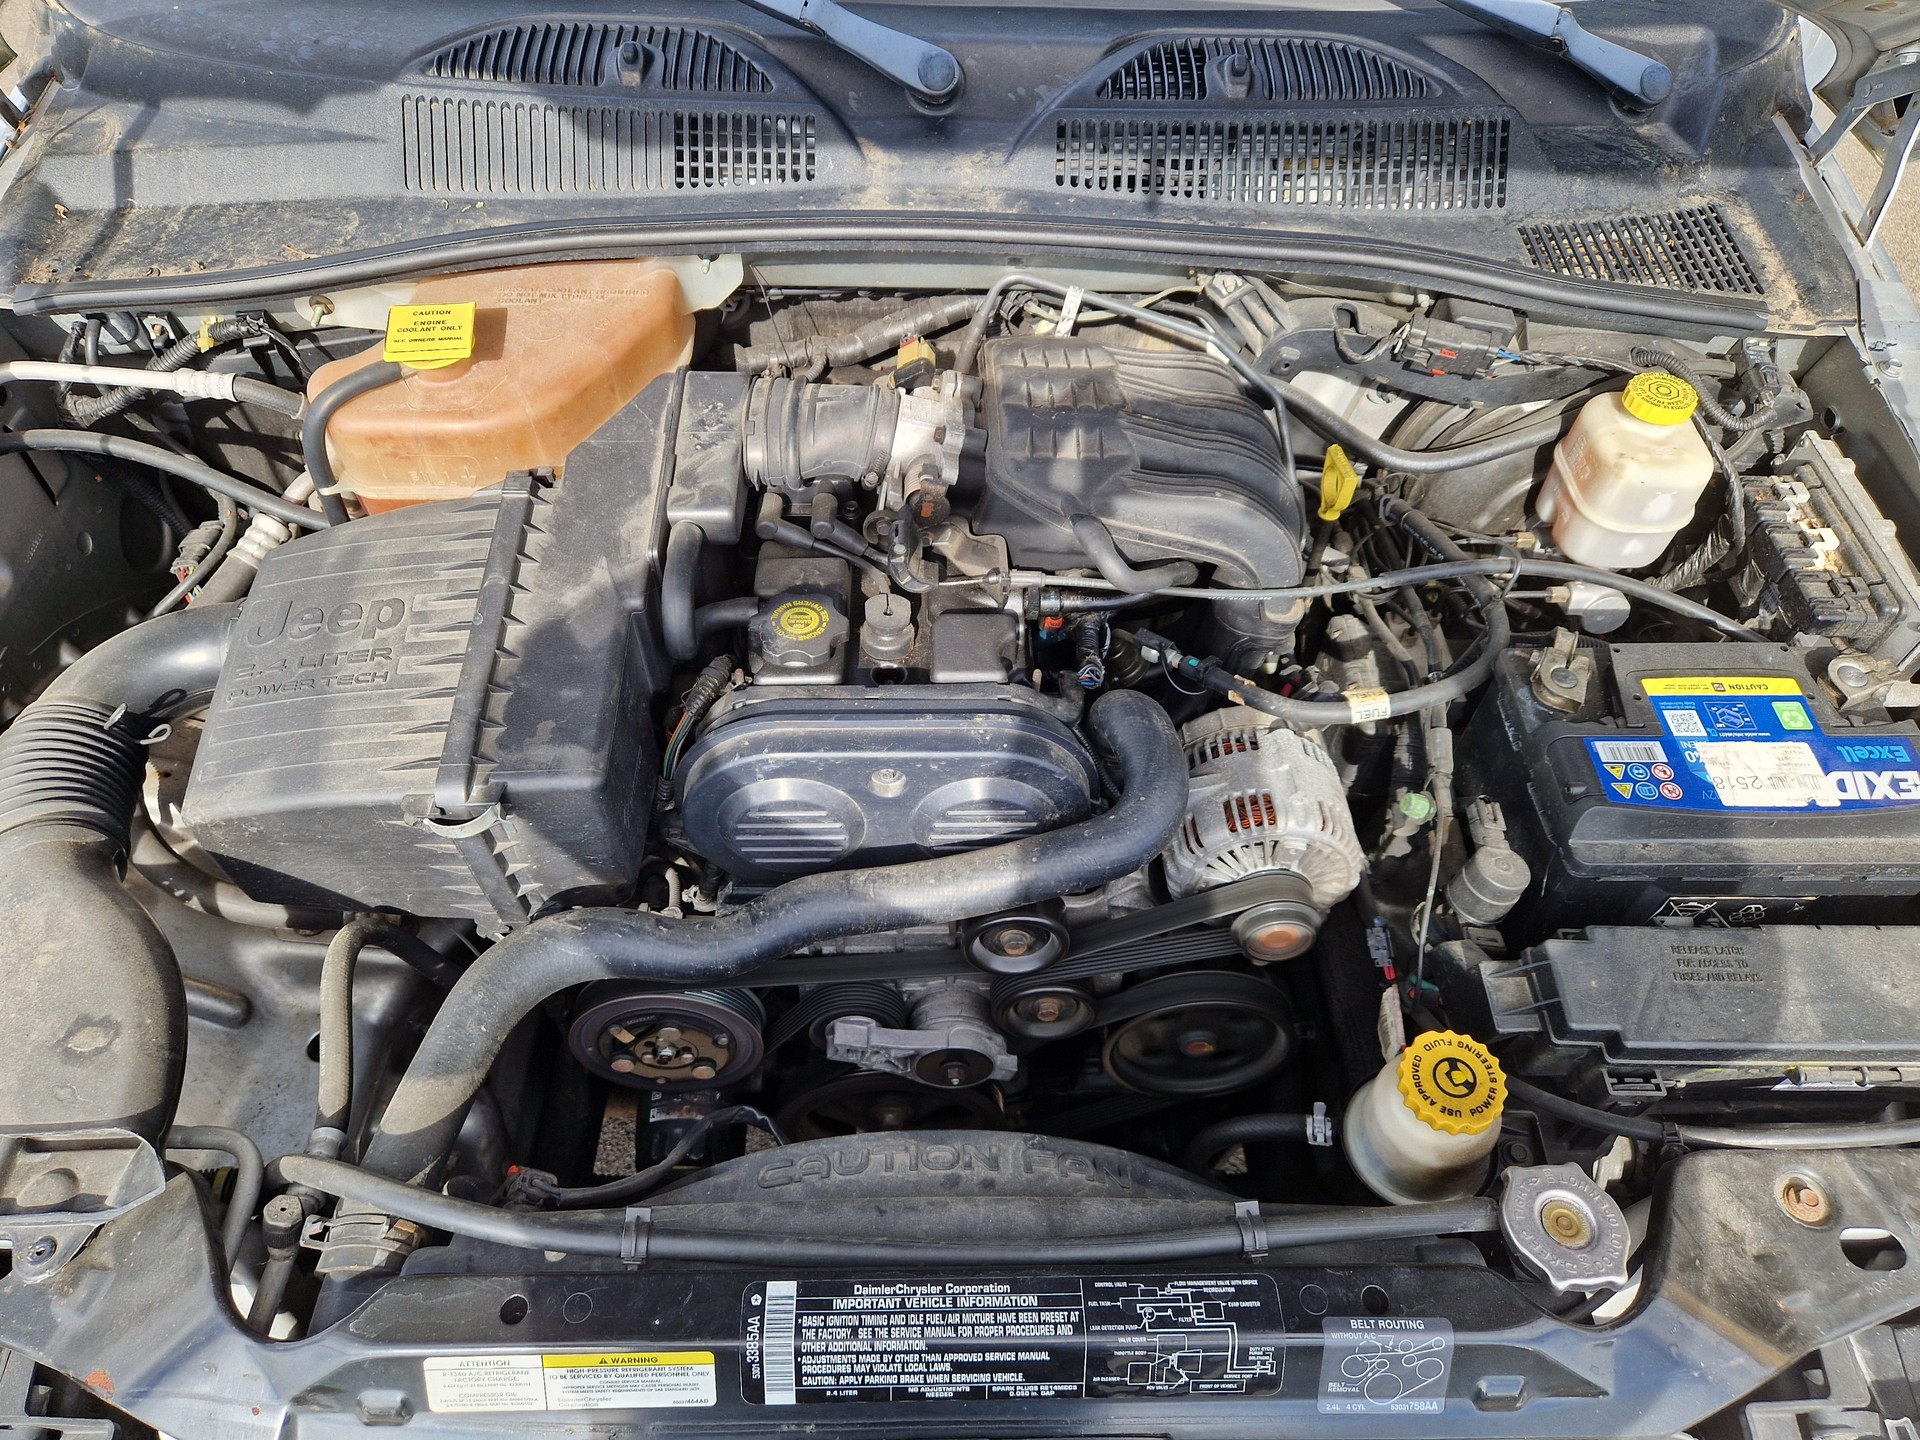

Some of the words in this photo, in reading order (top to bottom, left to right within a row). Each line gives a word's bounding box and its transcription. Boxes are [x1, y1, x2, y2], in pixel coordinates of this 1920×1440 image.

[771, 601, 792, 620] MANUAL
[793, 600, 822, 611] OWNERS
[819, 608, 830, 622] SEE
[247, 598, 405, 647] Jeep
[235, 659, 287, 680] 2.4
[299, 647, 393, 669] LITER
[226, 678, 315, 703] POWER
[322, 672, 389, 688] TECH
[1728, 682, 1769, 691] CAUTION
[1356, 707, 1387, 719] FUEL
[1837, 745, 1912, 763] Excell
[1714, 774, 1762, 790] 2518
[1670, 945, 1710, 955] RELEASE
[1714, 946, 1745, 956] LATCH
[1676, 958, 1696, 968] FOR
[1698, 959, 1734, 968] ACCESS
[1736, 959, 1748, 968] TO
[1672, 972, 1704, 981] FUSES
[1707, 972, 1725, 982] AND
[1423, 1039, 1452, 1051] FLUID
[1457, 1041, 1497, 1083] STEERING
[1412, 1055, 1437, 1106] APPROVED
[1469, 1087, 1497, 1116] POWER
[1440, 1105, 1462, 1118] USE
[756, 1144, 999, 1189] CAUTION
[1020, 1149, 1131, 1189] FAN
[854, 1283, 942, 1296] DaimlerChrysler
[945, 1283, 1011, 1295] Corporation
[832, 1298, 901, 1310] IMPORTANT
[905, 1297, 953, 1308] VEHICLE
[957, 1296, 1038, 1307] INFORMATION
[802, 1316, 824, 1327] BASIC
[826, 1315, 859, 1326] IGNITION
[861, 1315, 888, 1326] TIMING
[889, 1315, 906, 1325] AND
[907, 1313, 924, 1325] IDLE
[926, 1313, 960, 1326] FUEL/AIR
[962, 1313, 995, 1324] MIXTURE
[997, 1312, 1017, 1324] HAVE
[1019, 1312, 1039, 1323] BEEN
[1040, 1312, 1068, 1323] PRESET
[1070, 1311, 1080, 1323] AT
[1350, 1320, 1375, 1329] BELT
[1378, 1320, 1424, 1330] ROUTING
[802, 1329, 816, 1339] THE
[819, 1328, 853, 1339] FACTORY.
[858, 1328, 872, 1338] SEE
[875, 1328, 889, 1338] THE
[890, 1326, 922, 1338] SERVICE
[924, 1326, 956, 1337] MANUAL
[958, 1326, 972, 1336] FOR
[975, 1325, 1004, 1336] PROPER
[1006, 1325, 1055, 1336] PROCEDURES
[1057, 1324, 1073, 1335] AND
[801, 1342, 826, 1353] OTHER
[828, 1342, 872, 1352] ADDITIONAL
[874, 1340, 928, 1352] INFORMATION.
[801, 1355, 857, 1364] ADJUSTMENTS
[859, 1354, 881, 1363] MADE
[883, 1354, 893, 1362] BY
[894, 1354, 919, 1362] OTHER
[921, 1354, 942, 1362] THAN
[943, 1353, 983, 1361] APPROVED
[984, 1352, 1016, 1361] SERVICE
[1018, 1351, 1050, 1360] MANUAL
[802, 1364, 852, 1374] PROCEDURES
[853, 1364, 871, 1373] MAY
[872, 1363, 902, 1373] VIOLATE
[904, 1363, 927, 1372] LOCAL
[929, 1363, 953, 1372] LAWS.
[802, 1376, 837, 1385] CAUTION:
[839, 1376, 863, 1385] APPLY
[865, 1375, 898, 1384] PARKING
[899, 1374, 924, 1384] BRAKE
[926, 1374, 950, 1383] WHEN
[951, 1373, 991, 1382] SERVICING
[993, 1373, 1025, 1382] VEHICLE.
